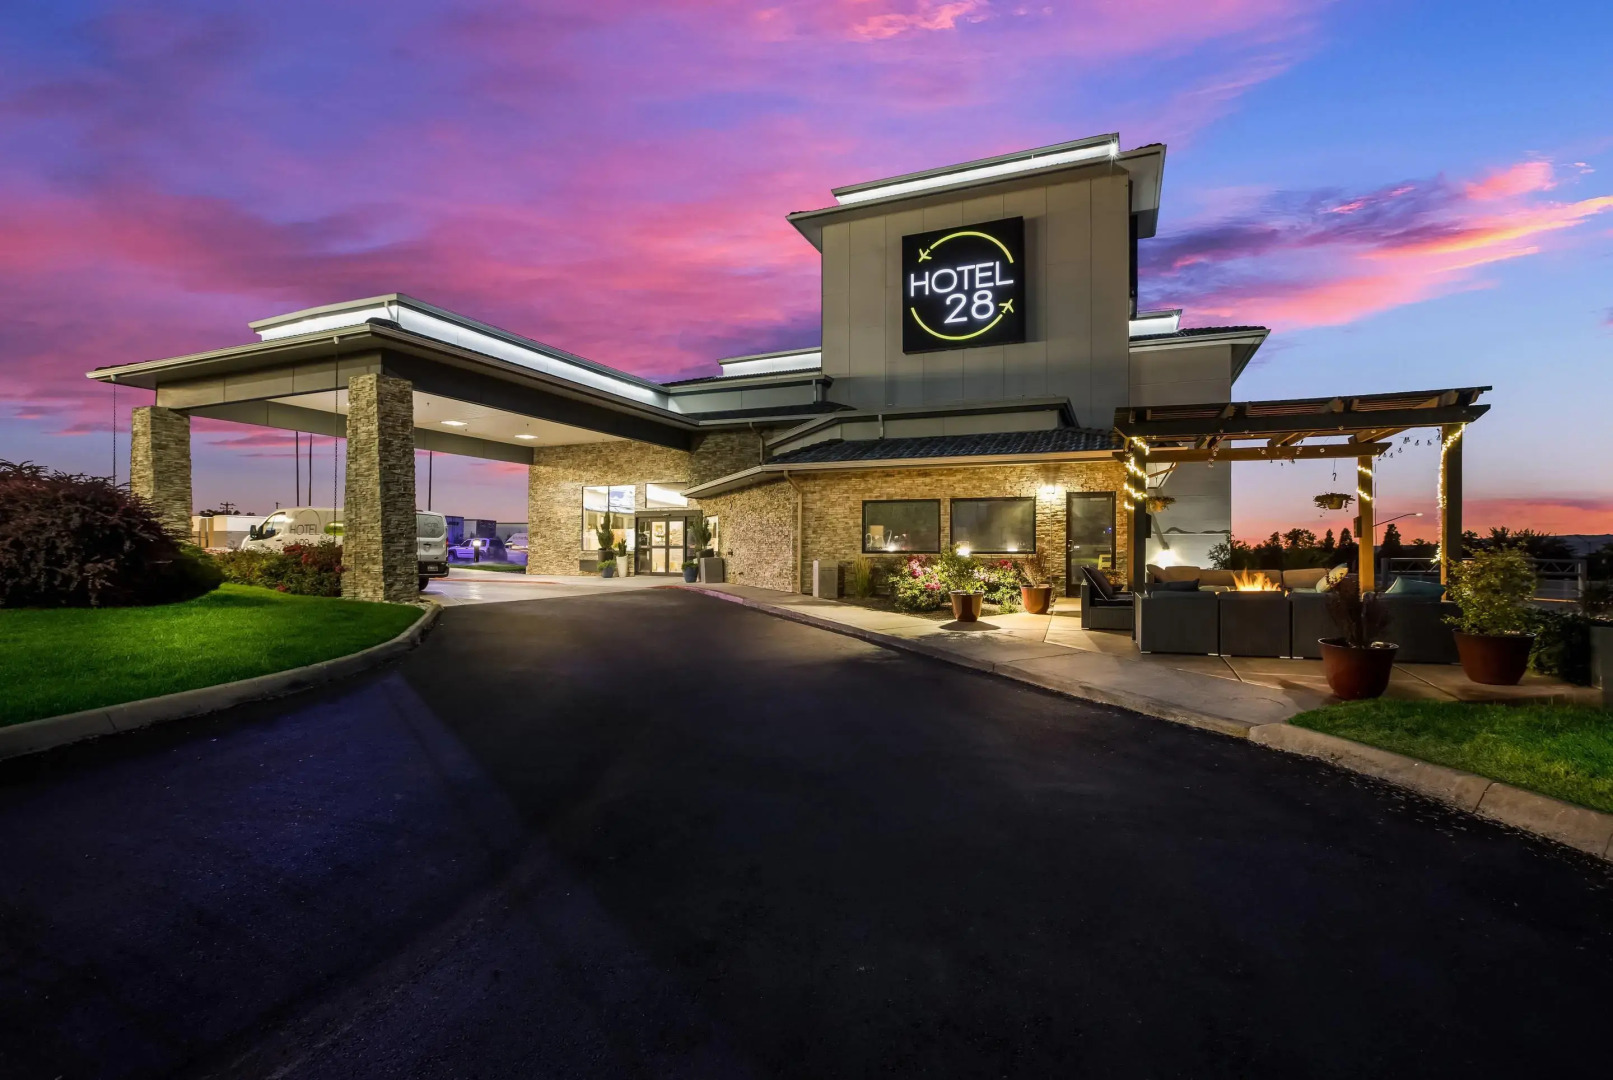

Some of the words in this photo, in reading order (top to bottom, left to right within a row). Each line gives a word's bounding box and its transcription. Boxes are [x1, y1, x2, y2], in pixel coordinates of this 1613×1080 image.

[910, 261, 1014, 297] HOTEL
[944, 290, 995, 324] 28
[289, 524, 320, 535] HOTEL
